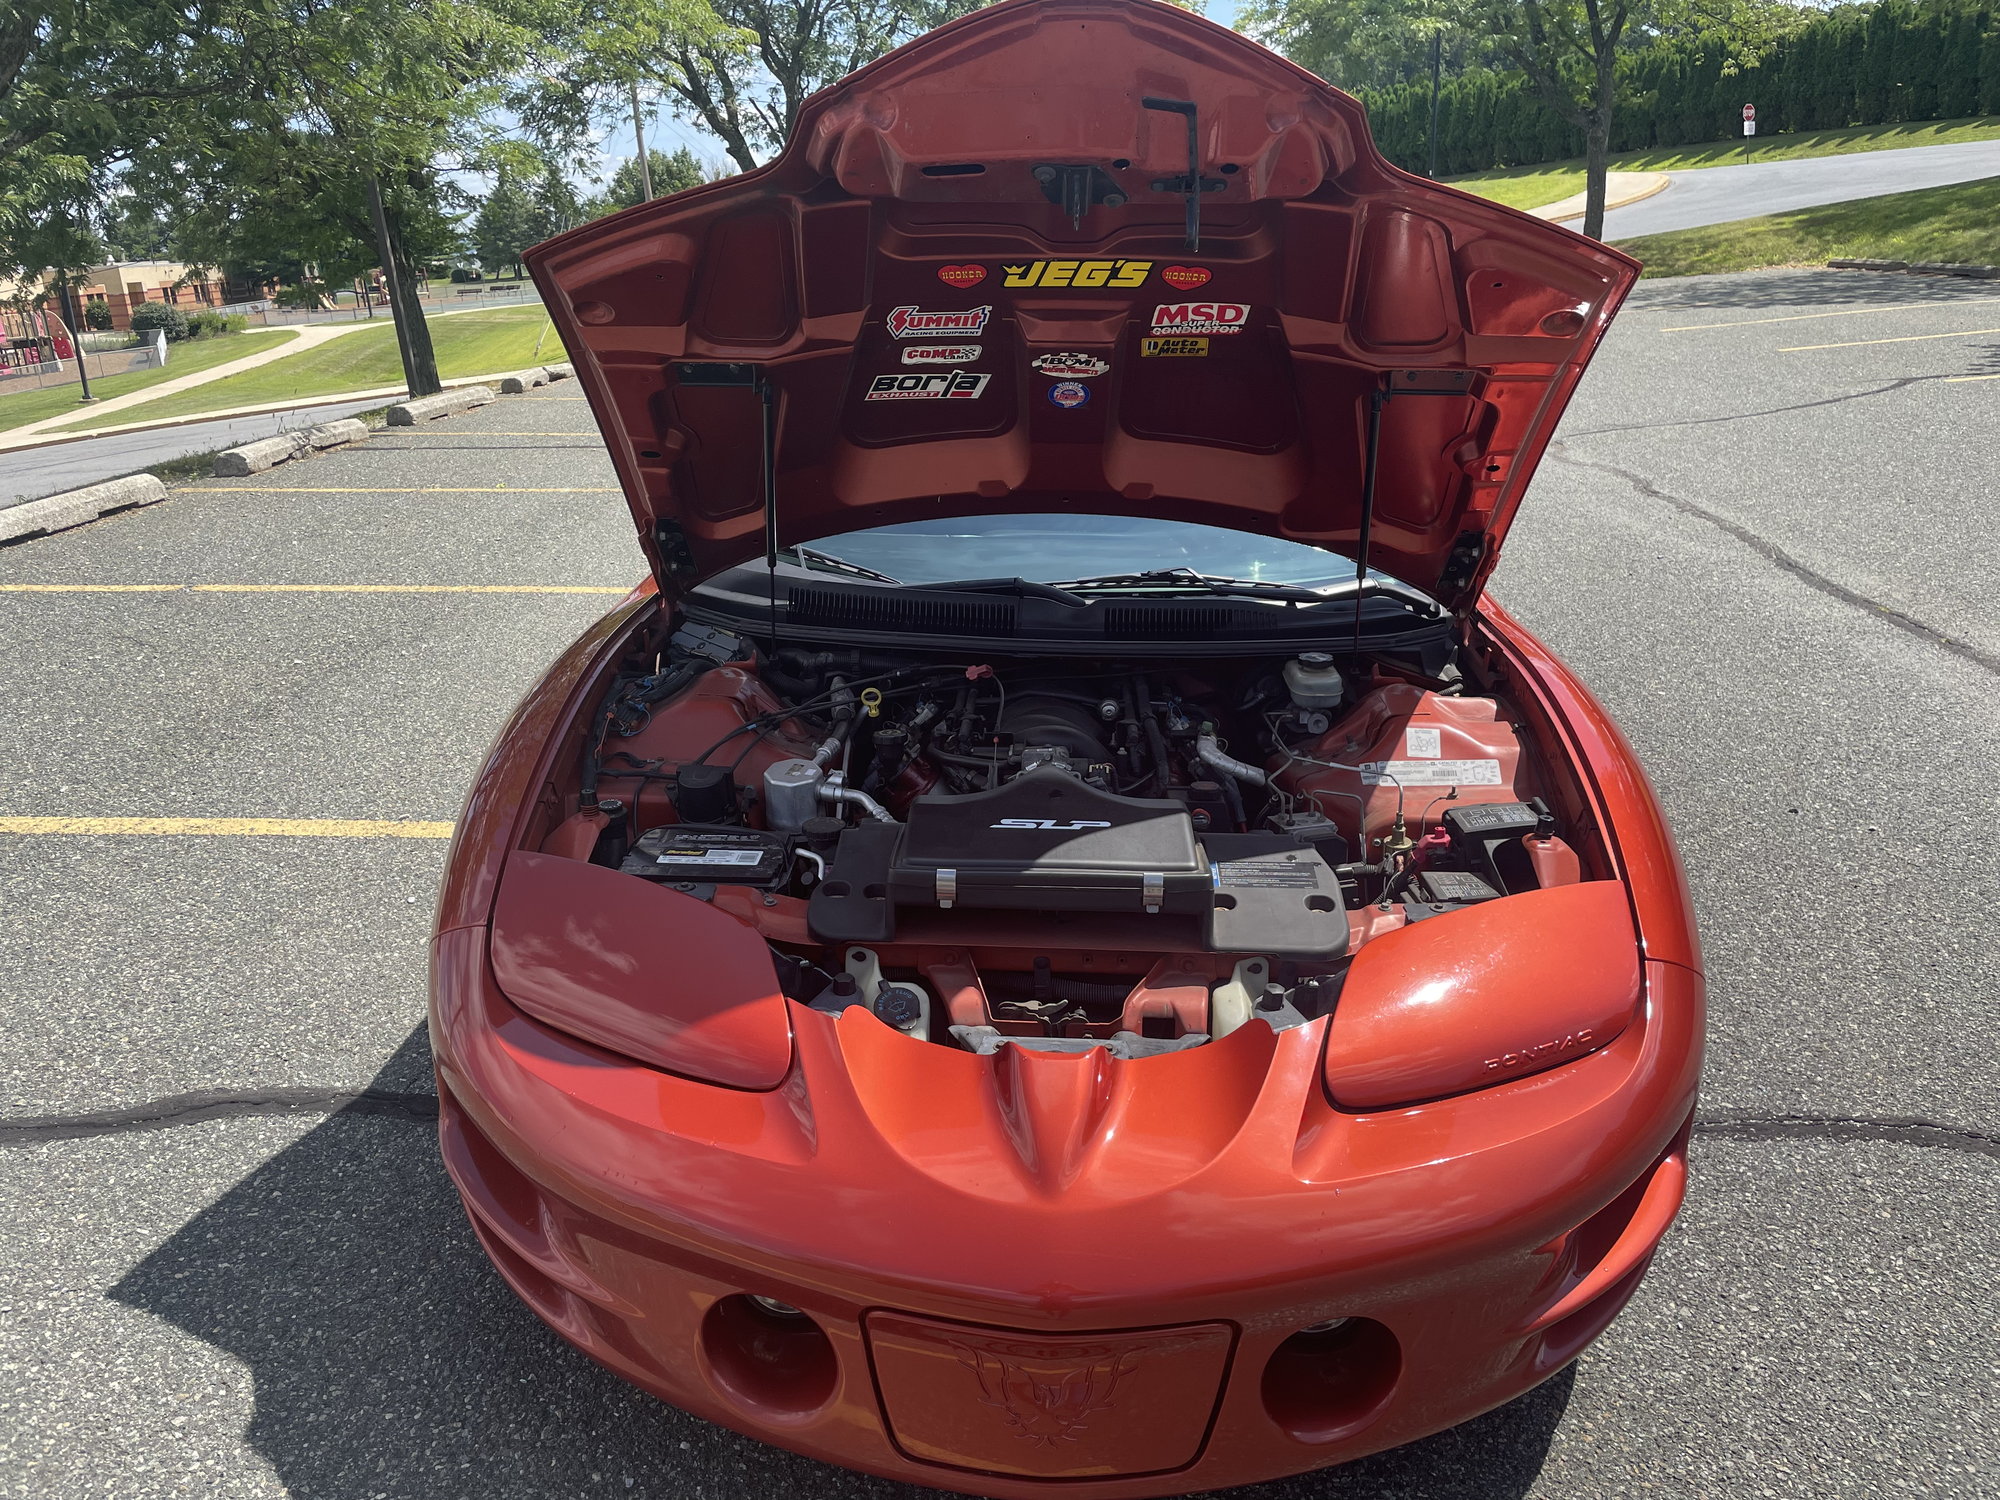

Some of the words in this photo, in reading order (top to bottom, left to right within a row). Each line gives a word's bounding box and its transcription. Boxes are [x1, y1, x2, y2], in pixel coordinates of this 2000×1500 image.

[942, 271, 983, 279] HOOKER
[1003, 260, 1153, 287] JEG'S
[1165, 272, 1206, 281] HOOKER
[1155, 304, 1244, 325] MSD
[1152, 326, 1242, 336] CONDUCTOR
[907, 349, 961, 359] COMP
[1048, 357, 1093, 366] B&M
[990, 819, 1111, 830] SLP
[1482, 1029, 1593, 1075] PONTIAC
